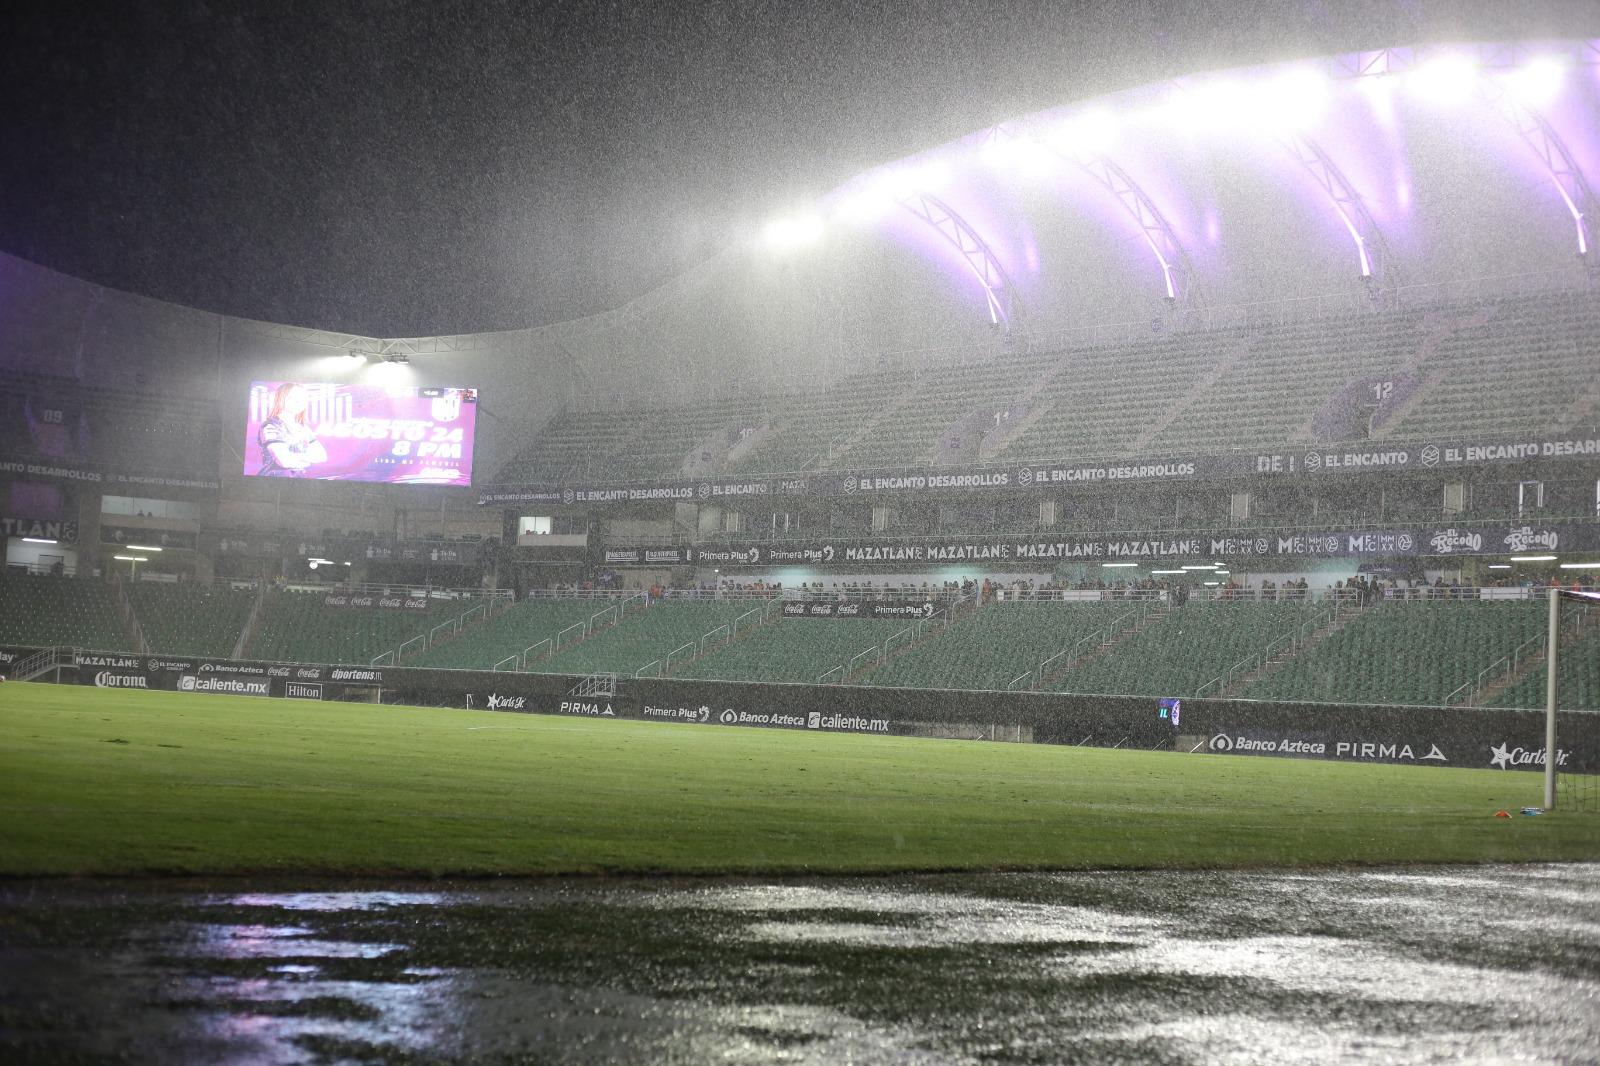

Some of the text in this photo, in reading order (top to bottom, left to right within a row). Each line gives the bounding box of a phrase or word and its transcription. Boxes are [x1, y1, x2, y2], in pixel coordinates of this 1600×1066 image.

[430, 427, 464, 443] 24
[392, 440, 462, 459] 8 PM
[1446, 449, 1462, 461] EL
[1466, 444, 1538, 460] ENCANTO
[1325, 452, 1408, 467] EL ENCANTO
[28, 464, 101, 482] DESARROLLOS
[1036, 464, 1195, 482] EL ENCANTO DESARROLLOS
[713, 484, 768, 495] EL ENCANTO
[861, 474, 1008, 490] EL ENCANTO DESARROLLOS
[576, 487, 693, 501] EL ENCANTO DESARROLLOS
[699, 550, 748, 560] Primera Plus
[770, 549, 822, 559] Primera Plus
[846, 547, 914, 560] MAZATLÁN
[927, 545, 1001, 559] MAZATLÁN
[1016, 543, 1094, 557] MAZATLÁN
[1109, 540, 1191, 555] MAZATLÁN
[875, 605, 923, 614] Primera Plus
[75, 657, 132, 668] MAZATLÁN
[215, 664, 264, 674] Banco Azteca
[95, 670, 146, 689] Corona
[197, 678, 266, 694] caliente.mx
[289, 685, 319, 698] Hilton
[496, 696, 525, 709] Carl's Jr.
[560, 702, 599, 715] PIRMA
[644, 706, 697, 718] Primera Plus
[739, 711, 804, 726] Banco Azteca
[821, 714, 890, 732] caliente.mx
[1235, 736, 1326, 755] Banco Azteca
[1336, 741, 1415, 760] PIRMA
[1510, 747, 1547, 765] Carl's
